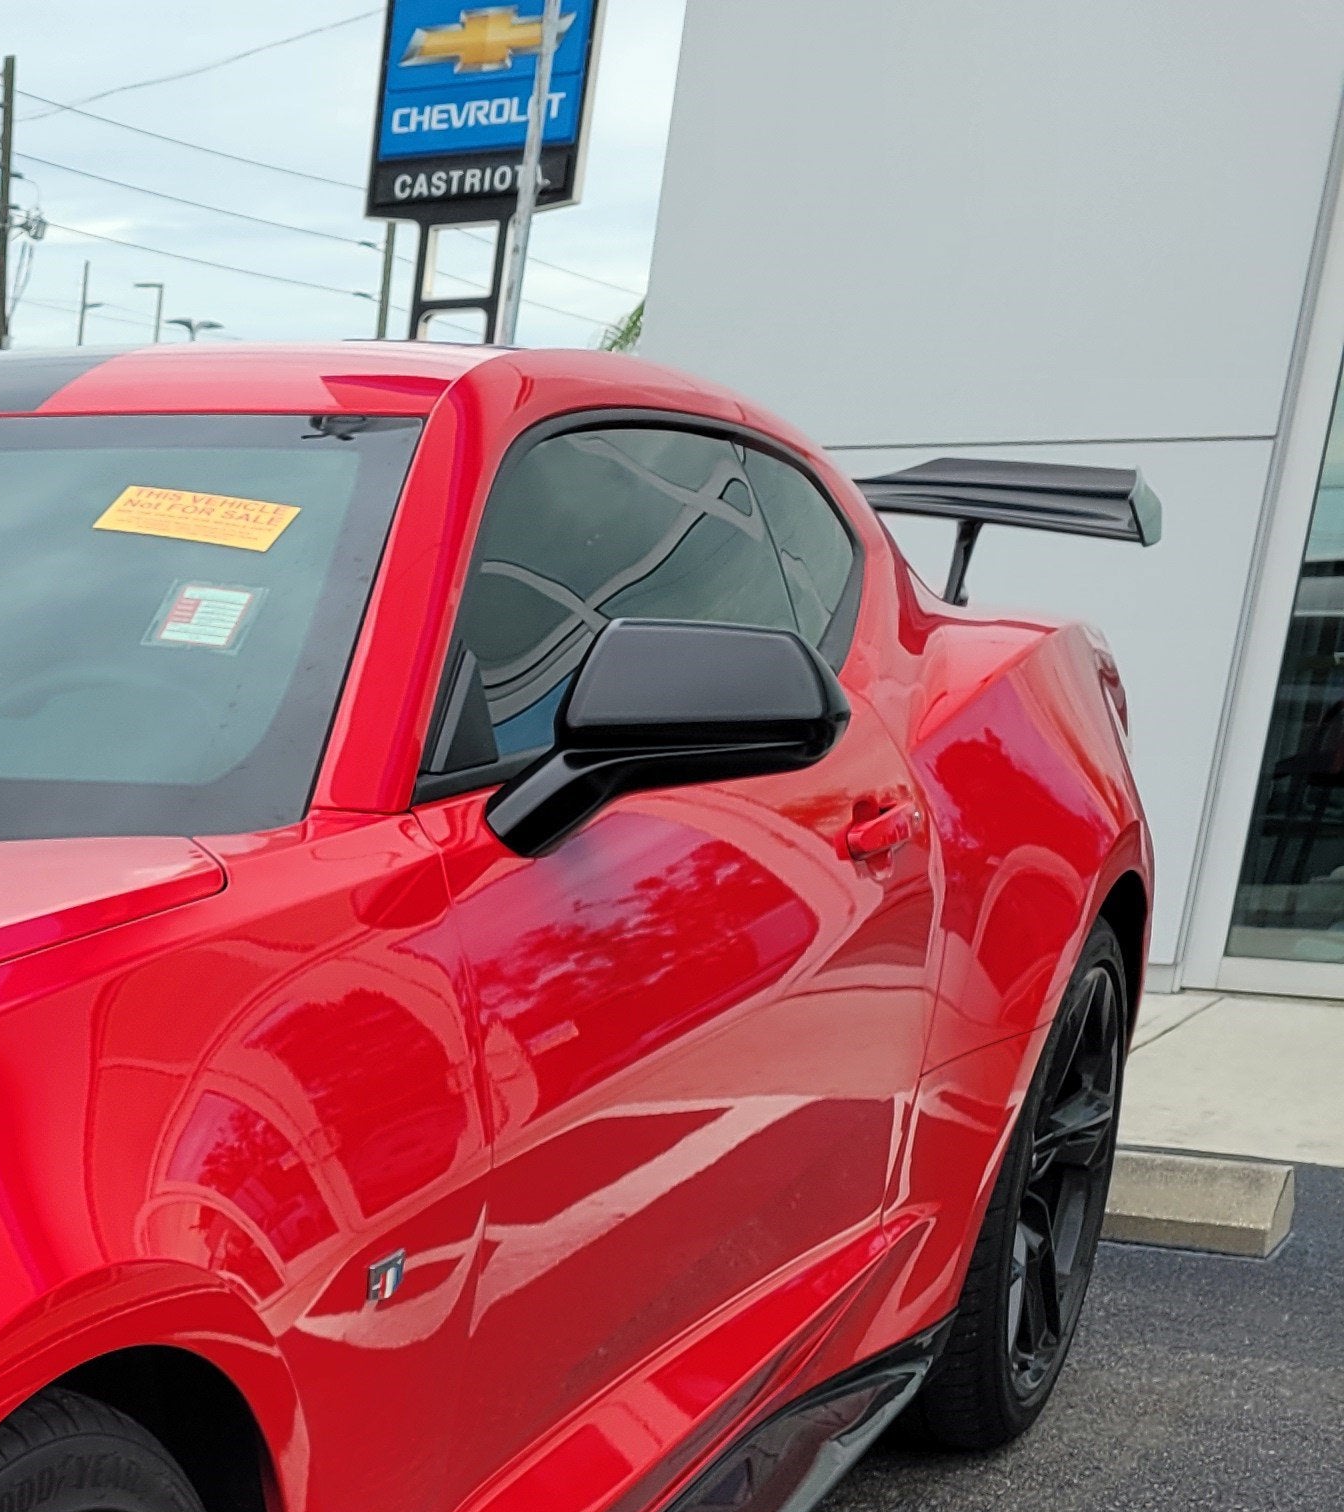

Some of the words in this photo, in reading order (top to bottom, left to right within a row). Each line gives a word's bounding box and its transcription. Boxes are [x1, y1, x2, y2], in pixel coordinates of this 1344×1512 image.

[135, 488, 182, 501] THIS
[191, 494, 288, 516] VEHICLE
[166, 503, 213, 517] FOR
[220, 509, 283, 526] SALE
